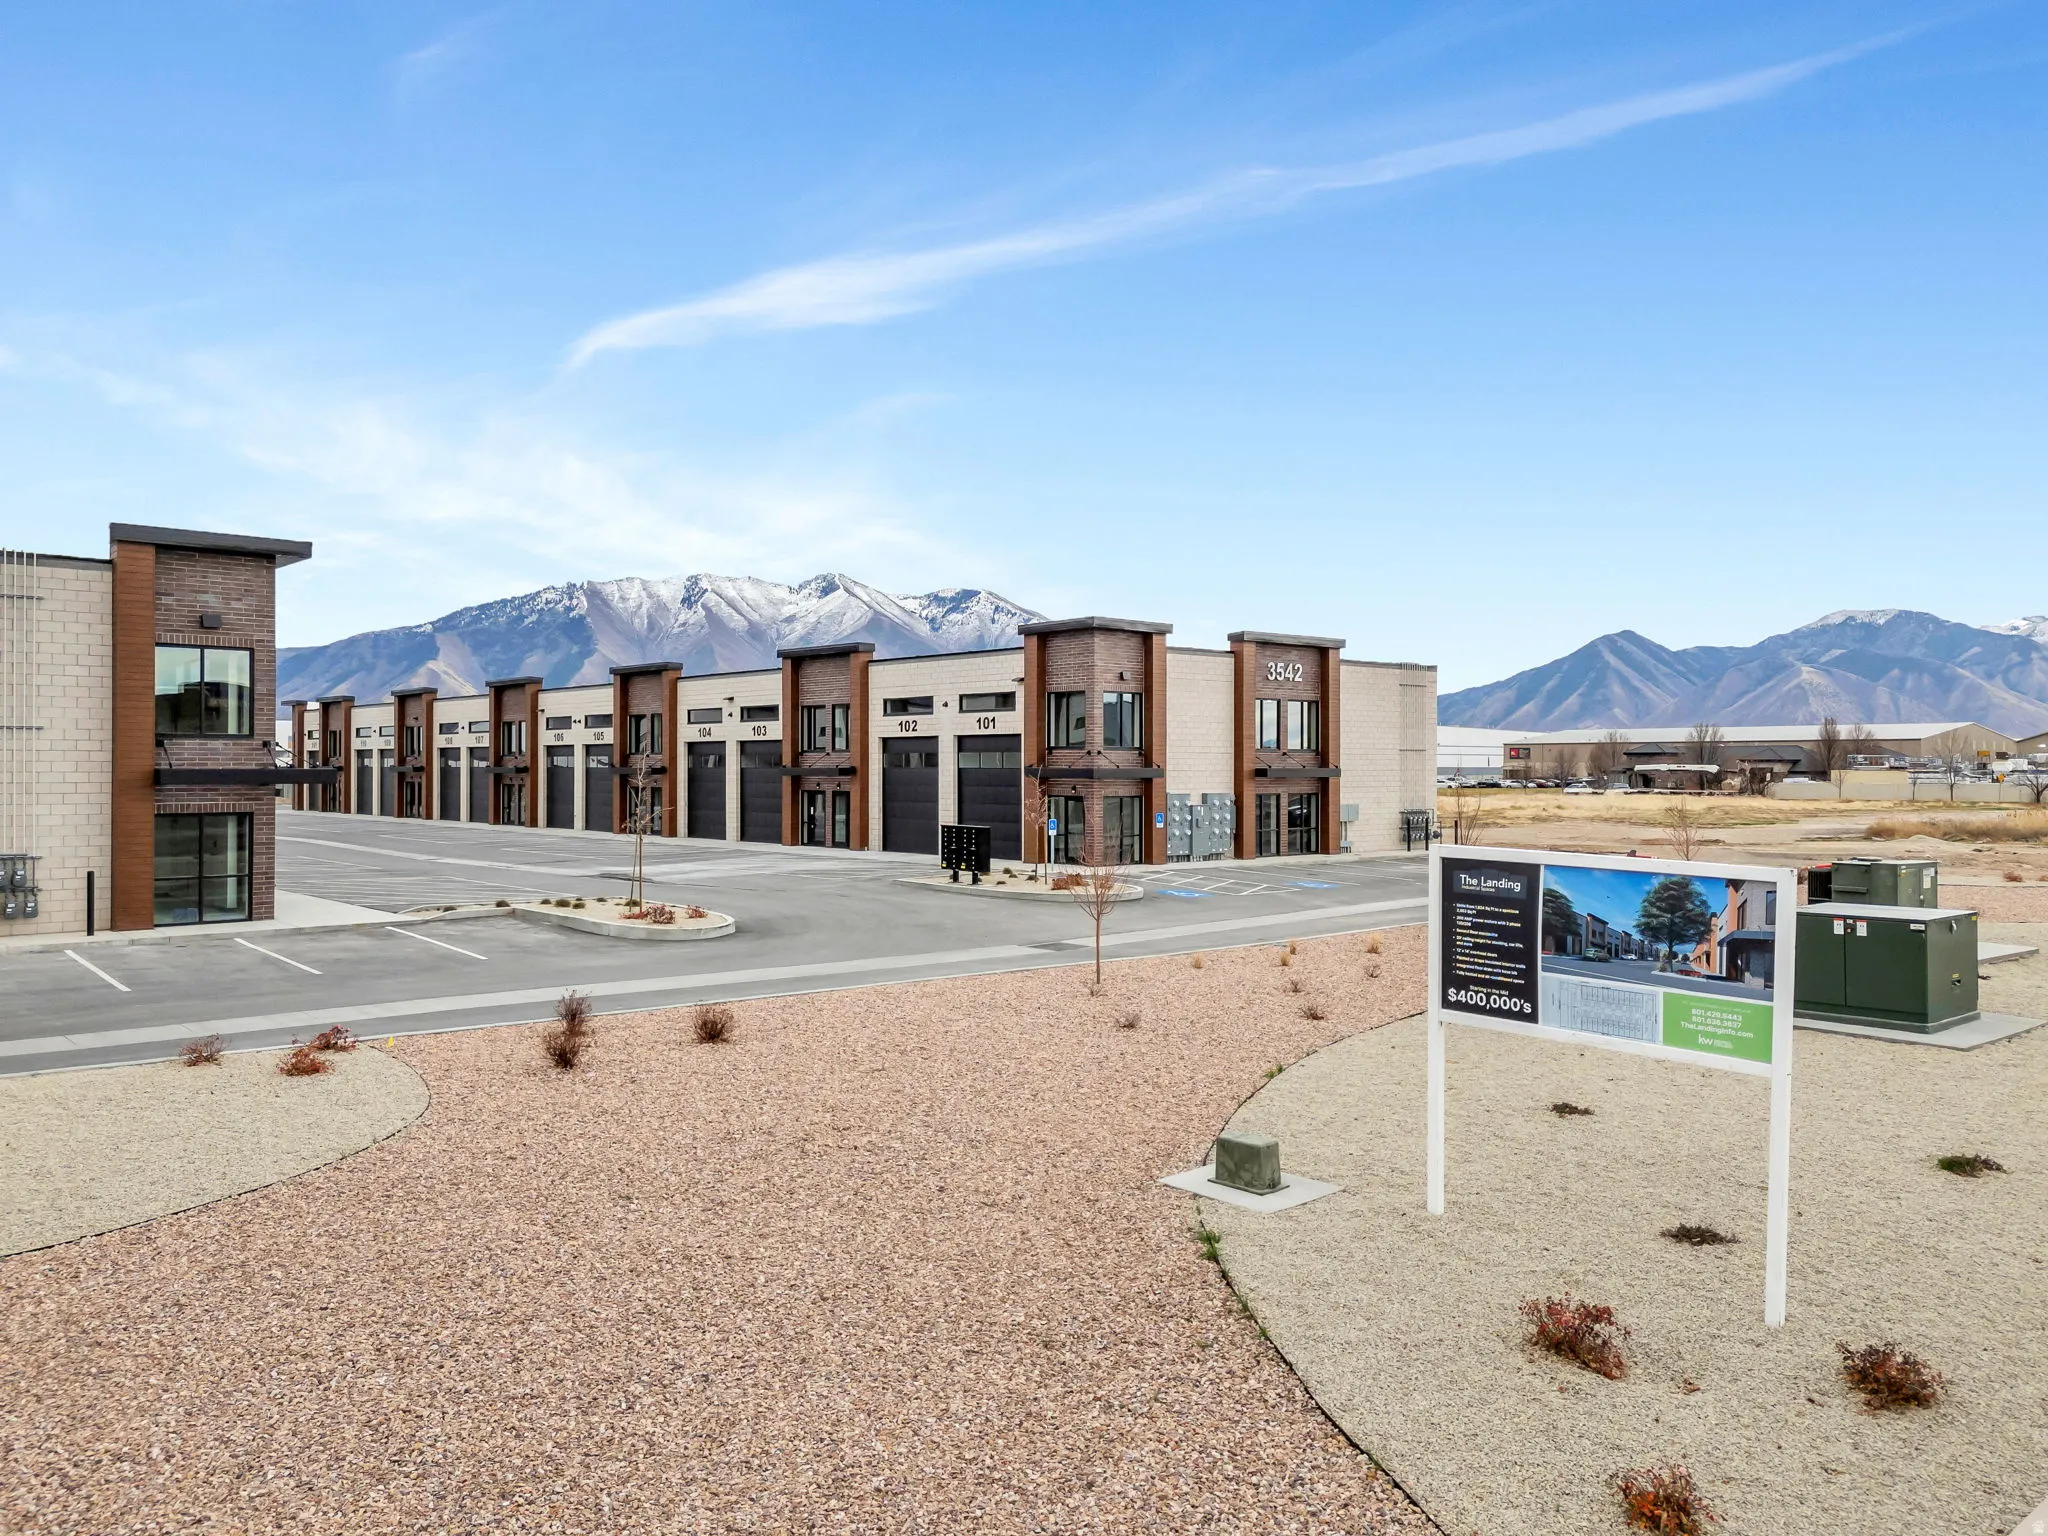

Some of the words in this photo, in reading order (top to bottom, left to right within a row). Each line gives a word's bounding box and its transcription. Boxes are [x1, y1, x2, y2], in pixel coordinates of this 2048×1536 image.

[1267, 661, 1303, 682] 3542
[898, 719, 918, 732] 102
[976, 716, 996, 730] 101
[593, 731, 605, 741] 105
[698, 727, 712, 738] 104
[752, 725, 767, 737] 103
[553, 733, 565, 742] 106
[1460, 874, 1478, 886] The
[1481, 876, 1521, 892] Landing
